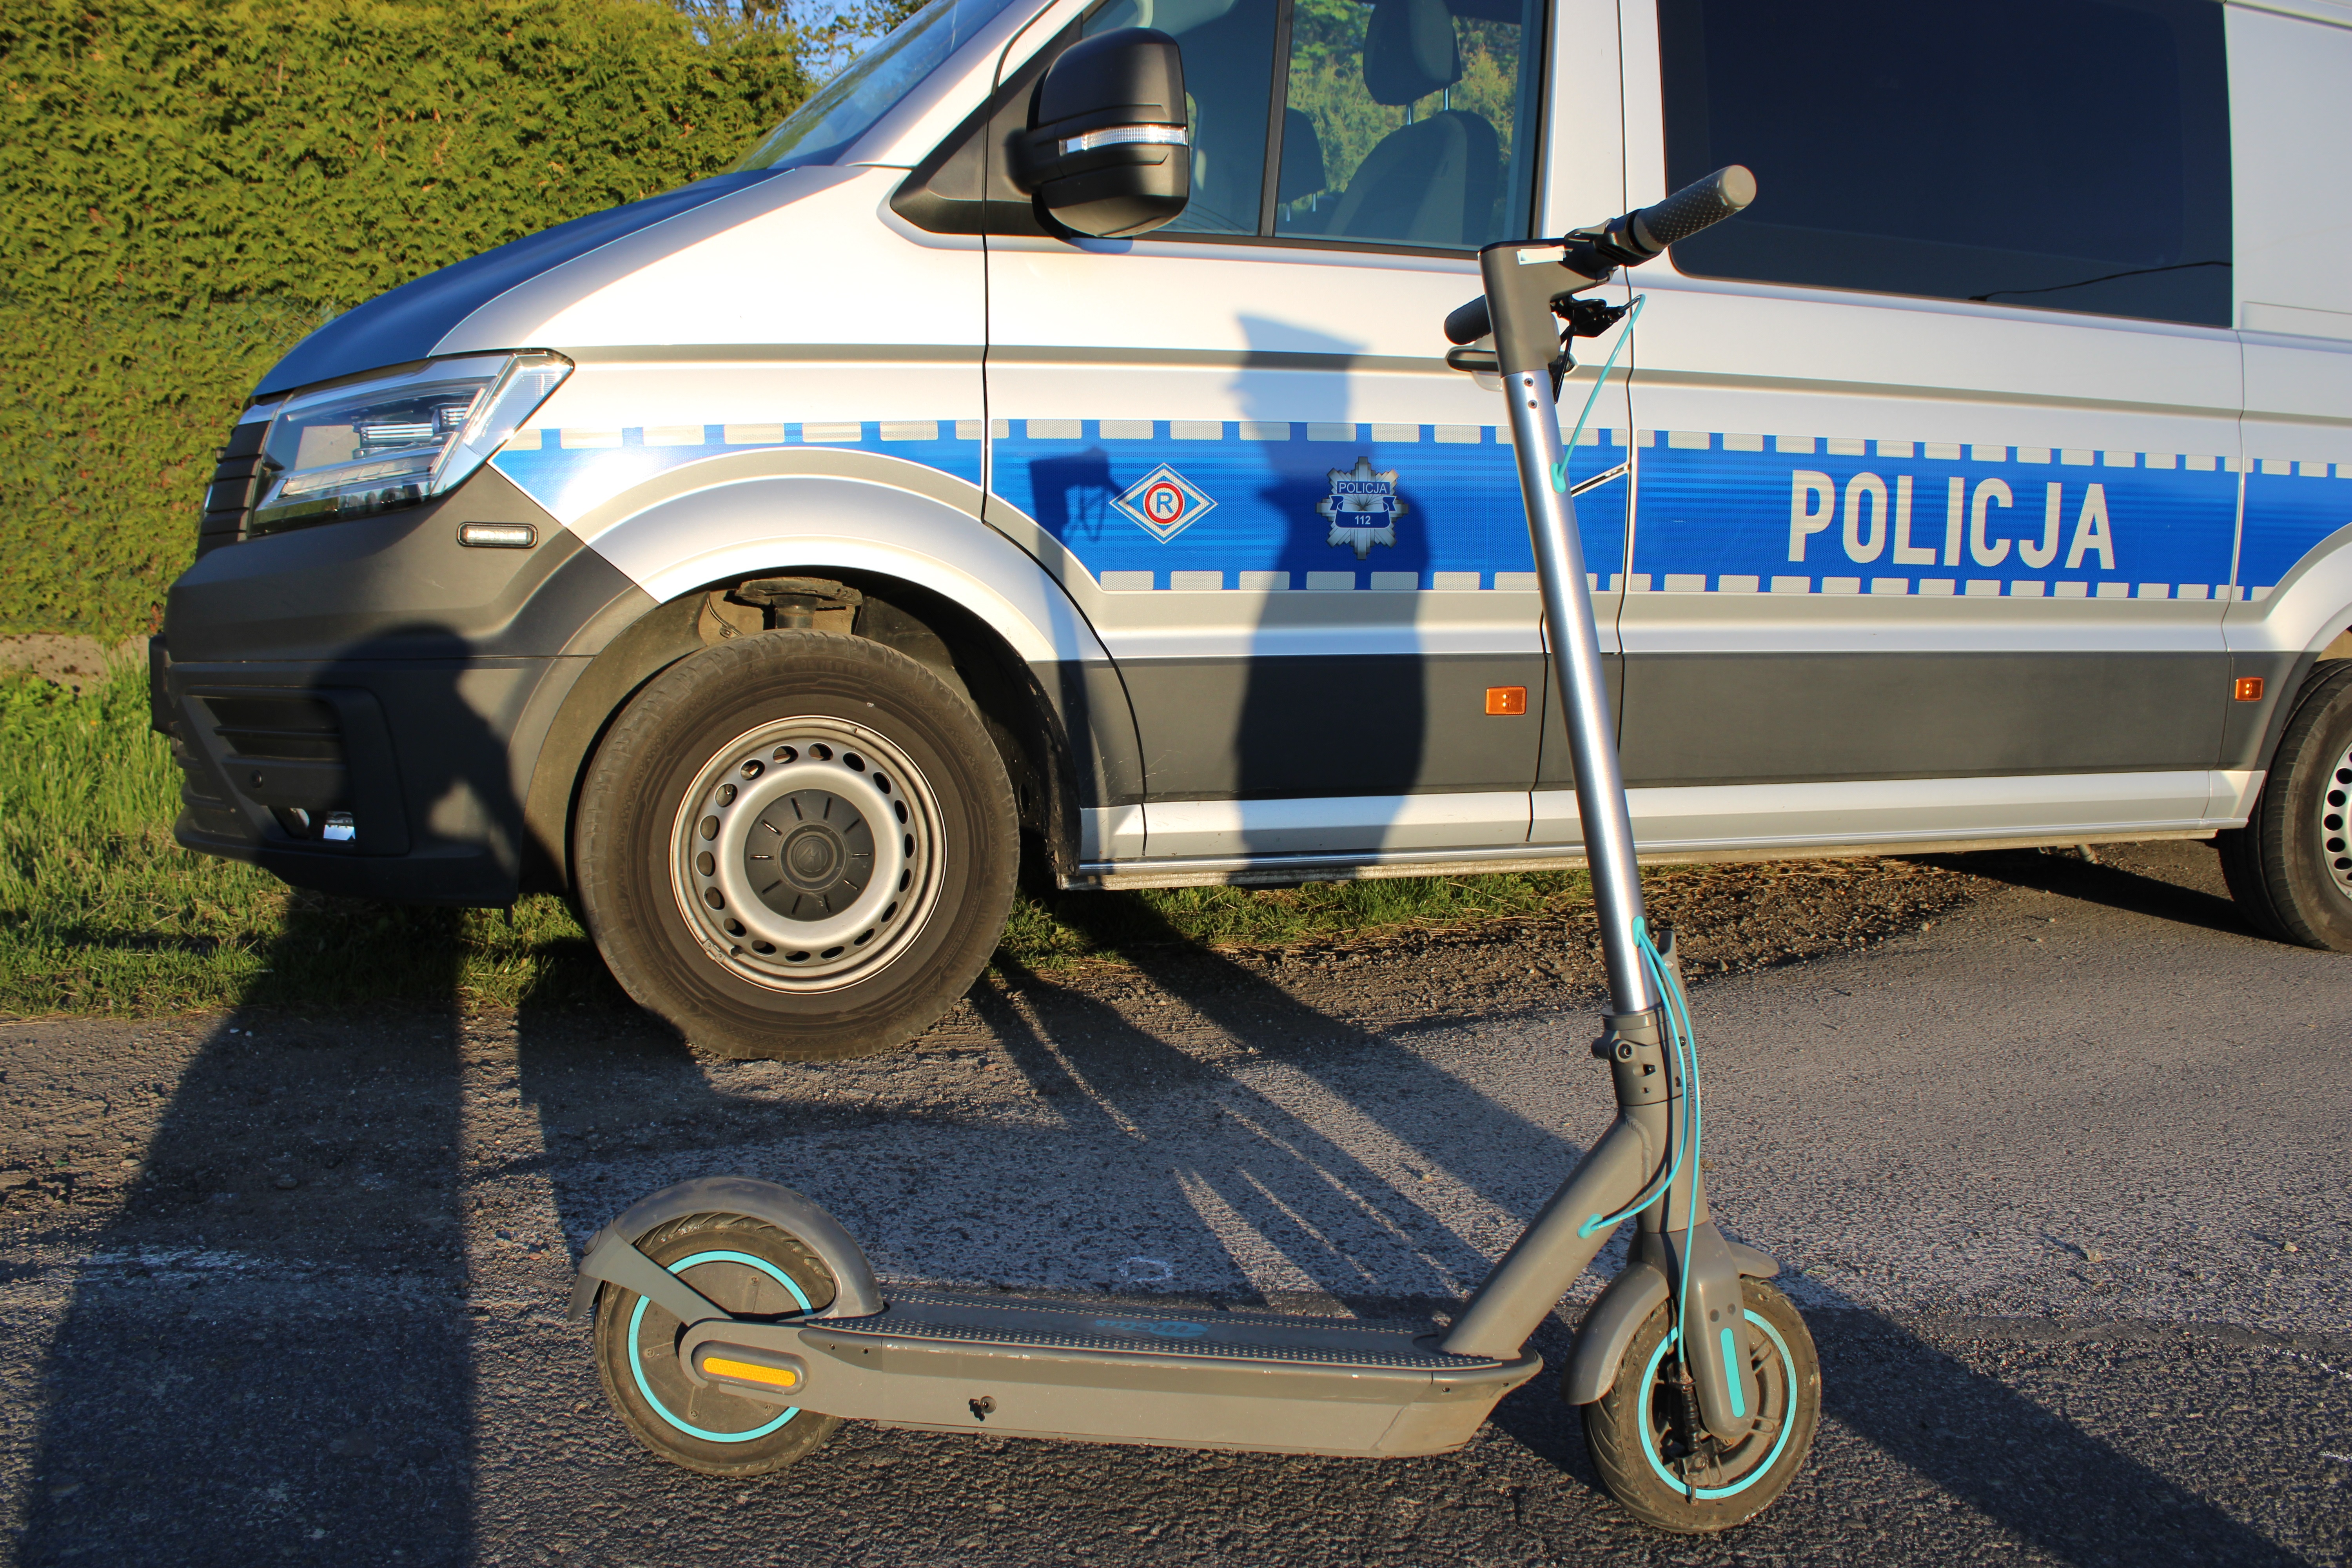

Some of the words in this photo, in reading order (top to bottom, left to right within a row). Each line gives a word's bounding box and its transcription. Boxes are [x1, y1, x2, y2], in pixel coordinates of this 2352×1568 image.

[1339, 482, 1388, 494] POLICJA
[1156, 492, 1173, 514] R
[1354, 515, 1371, 525] 112
[1788, 470, 2115, 570] POLICJA
